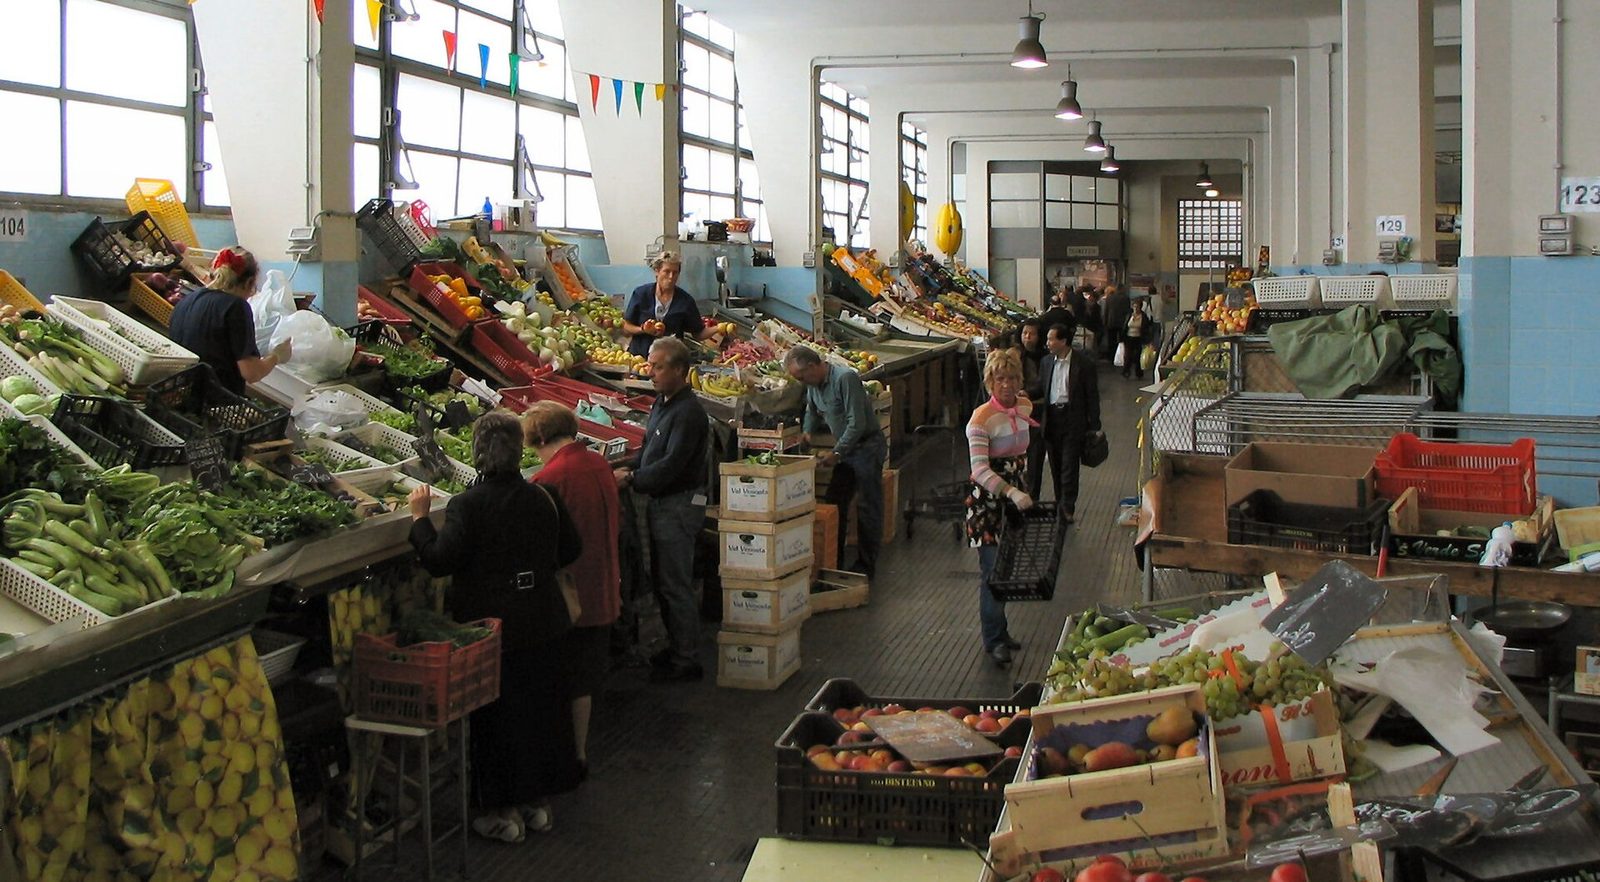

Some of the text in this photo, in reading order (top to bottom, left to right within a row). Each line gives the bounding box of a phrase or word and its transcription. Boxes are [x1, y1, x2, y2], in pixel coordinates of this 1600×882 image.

[1561, 185, 1600, 204] 123
[0, 217, 24, 236] 104
[1380, 220, 1402, 231] 129
